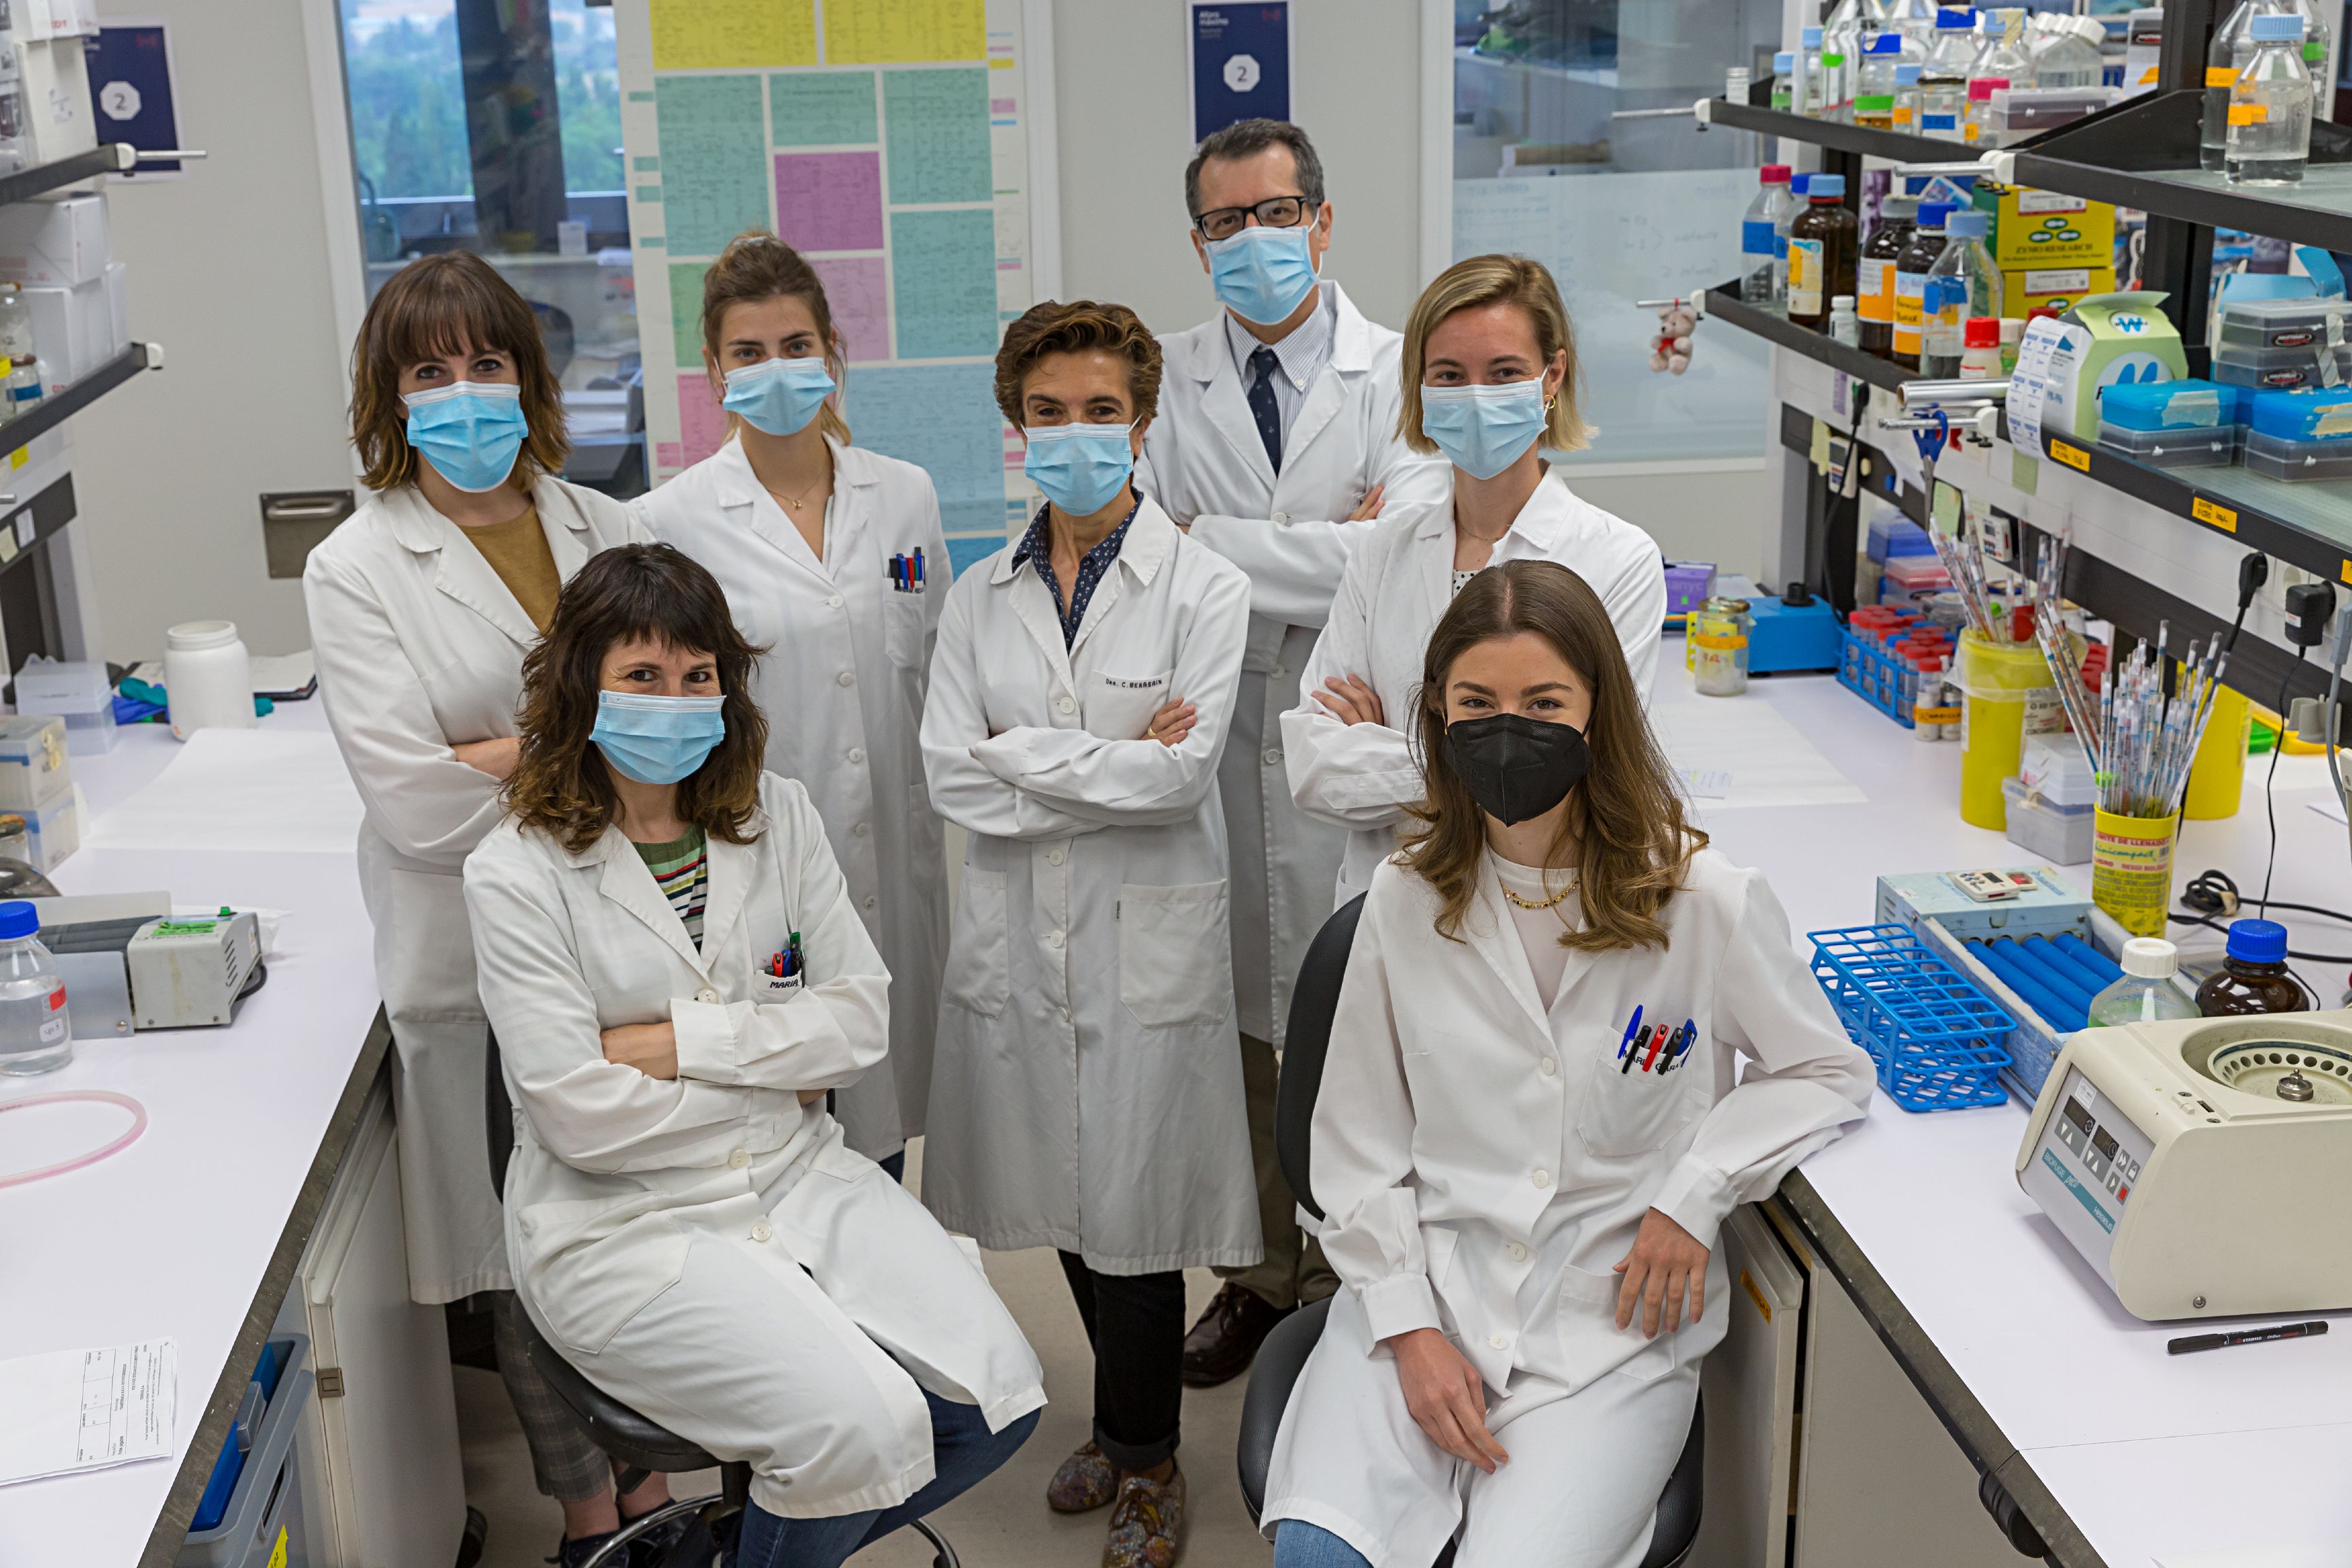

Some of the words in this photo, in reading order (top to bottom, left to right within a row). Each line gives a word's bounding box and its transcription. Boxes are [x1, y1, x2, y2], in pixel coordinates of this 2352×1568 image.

[1237, 66, 1247, 82] 2
[114, 93, 127, 111] 2
[1129, 679, 1162, 689] BERASAIN
[770, 979, 799, 989] MARIA
[2044, 1152, 2065, 1177] BIOFUGE
[2063, 1175, 2079, 1190] pico
[2093, 1205, 2113, 1231] Heraeus
